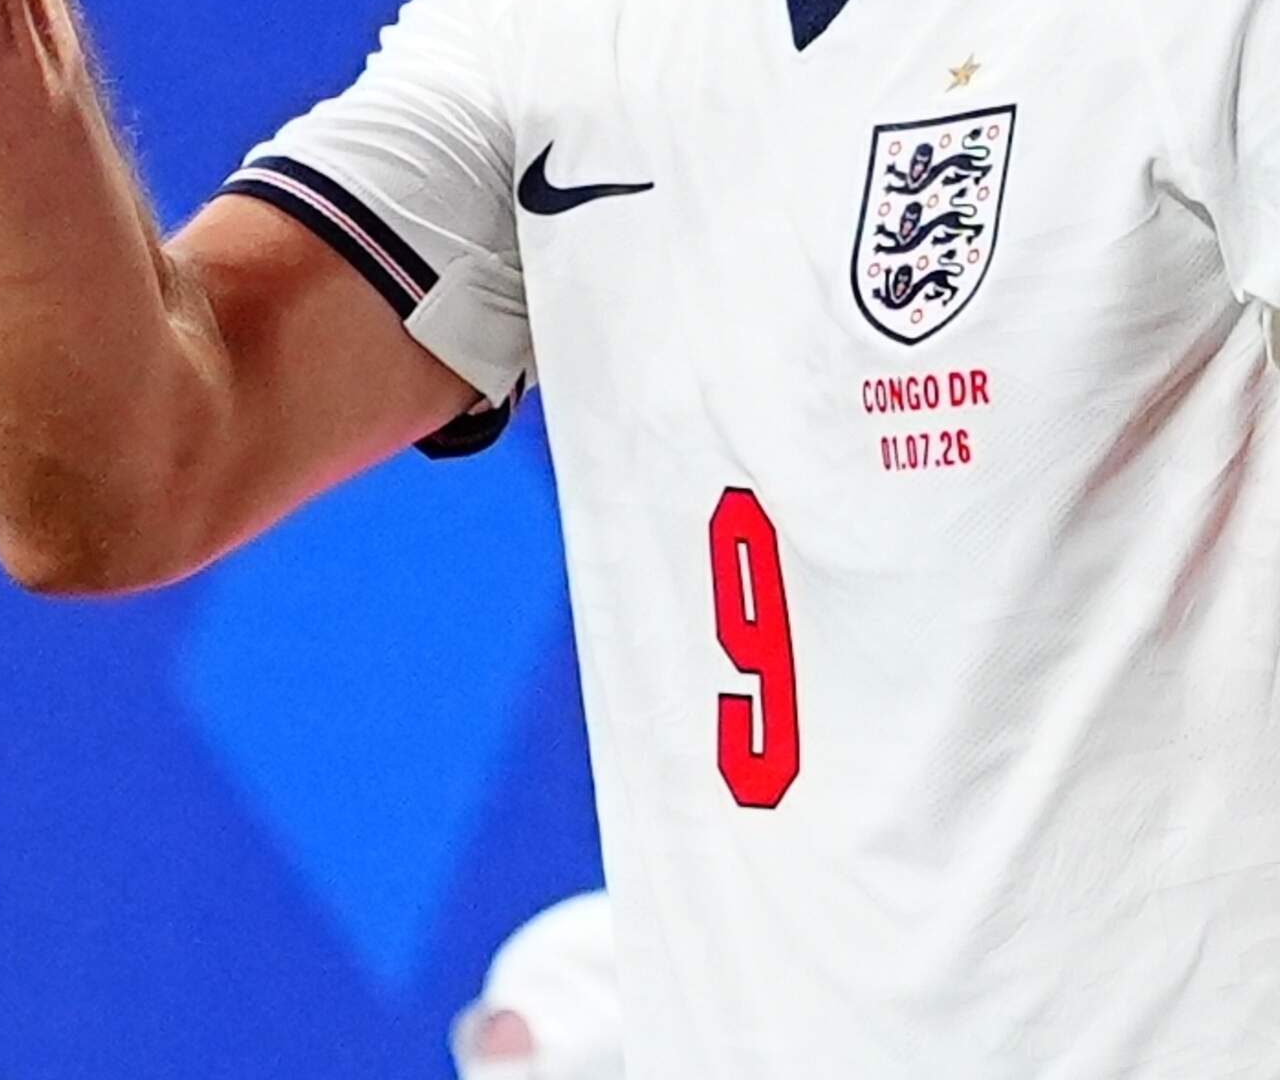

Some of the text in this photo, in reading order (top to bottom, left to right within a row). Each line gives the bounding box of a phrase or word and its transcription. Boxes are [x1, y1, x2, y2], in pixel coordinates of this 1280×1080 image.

[862, 369, 989, 414] CONGO DR
[881, 429, 971, 471] 01.07.26
[709, 485, 800, 810] 9
